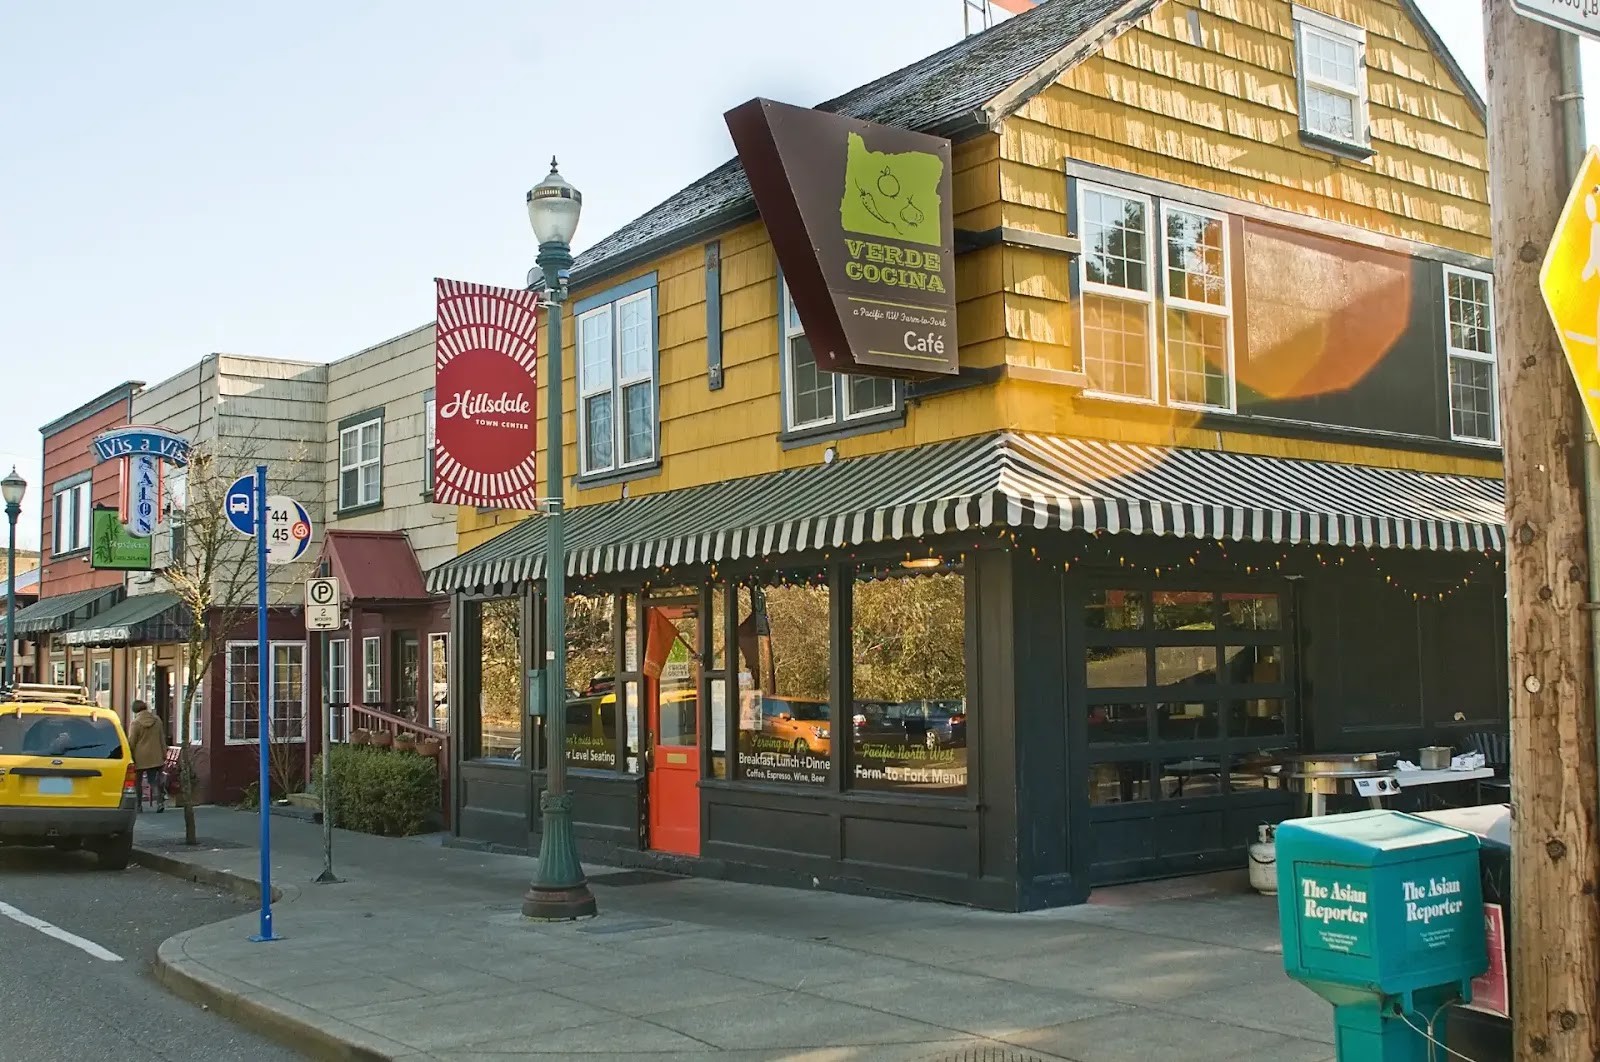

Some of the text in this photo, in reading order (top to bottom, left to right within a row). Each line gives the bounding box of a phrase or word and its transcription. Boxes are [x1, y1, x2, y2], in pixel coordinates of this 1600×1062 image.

[844, 238, 941, 272] VERDE
[845, 261, 946, 293] COCINA
[860, 307, 884, 320] Pacific
[886, 311, 900, 320] NW
[903, 330, 945, 354] Café
[440, 389, 531, 419] Hillsdale
[475, 419, 529, 429] TOWN CENTER
[103, 438, 187, 463] Vis a Vis
[138, 455, 154, 535] SALON
[271, 510, 288, 522] 44
[272, 528, 289, 541] 45
[318, 585, 329, 600] P
[320, 607, 327, 617] 2
[102, 626, 129, 640] SALON
[572, 749, 589, 761] Level
[590, 749, 616, 766] Seating
[776, 754, 800, 769] Lunch
[862, 743, 955, 762] Pacific North West
[766, 769, 792, 781] Espresso,
[793, 772, 810, 782] Wine,
[811, 773, 826, 782] Beer
[931, 768, 964, 785] Menu
[1301, 877, 1367, 904] The Asian
[1402, 876, 1461, 901] The Asian
[1303, 898, 1369, 925] Reporter
[1406, 898, 1463, 924] Reporter
